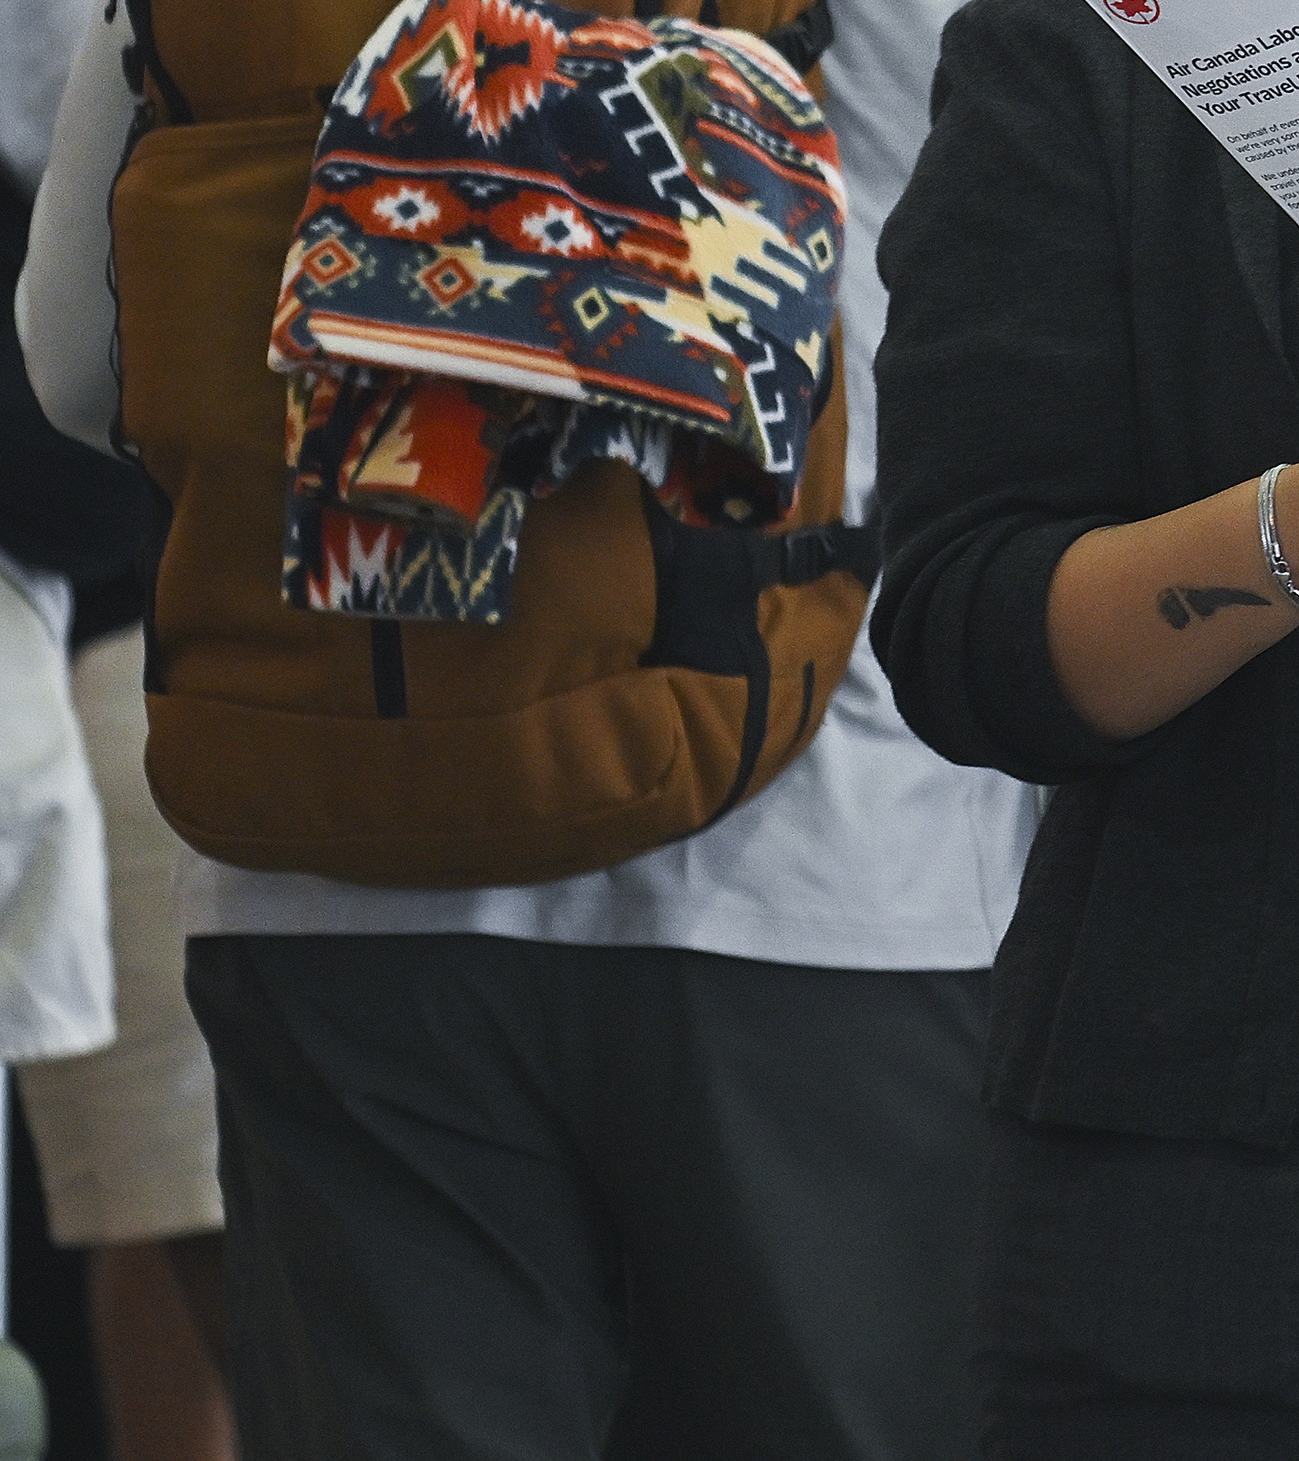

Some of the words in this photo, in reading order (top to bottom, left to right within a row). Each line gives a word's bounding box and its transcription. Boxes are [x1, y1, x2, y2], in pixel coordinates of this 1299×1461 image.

[1165, 62, 1192, 79] Air
[1191, 43, 1261, 72] Canada
[1180, 56, 1293, 98] Negotiations
[1197, 98, 1242, 117] Your
[1239, 126, 1269, 141] behalf
[1235, 142, 1262, 153] we're
[1244, 149, 1276, 163] caused
[1270, 178, 1297, 191] travel
